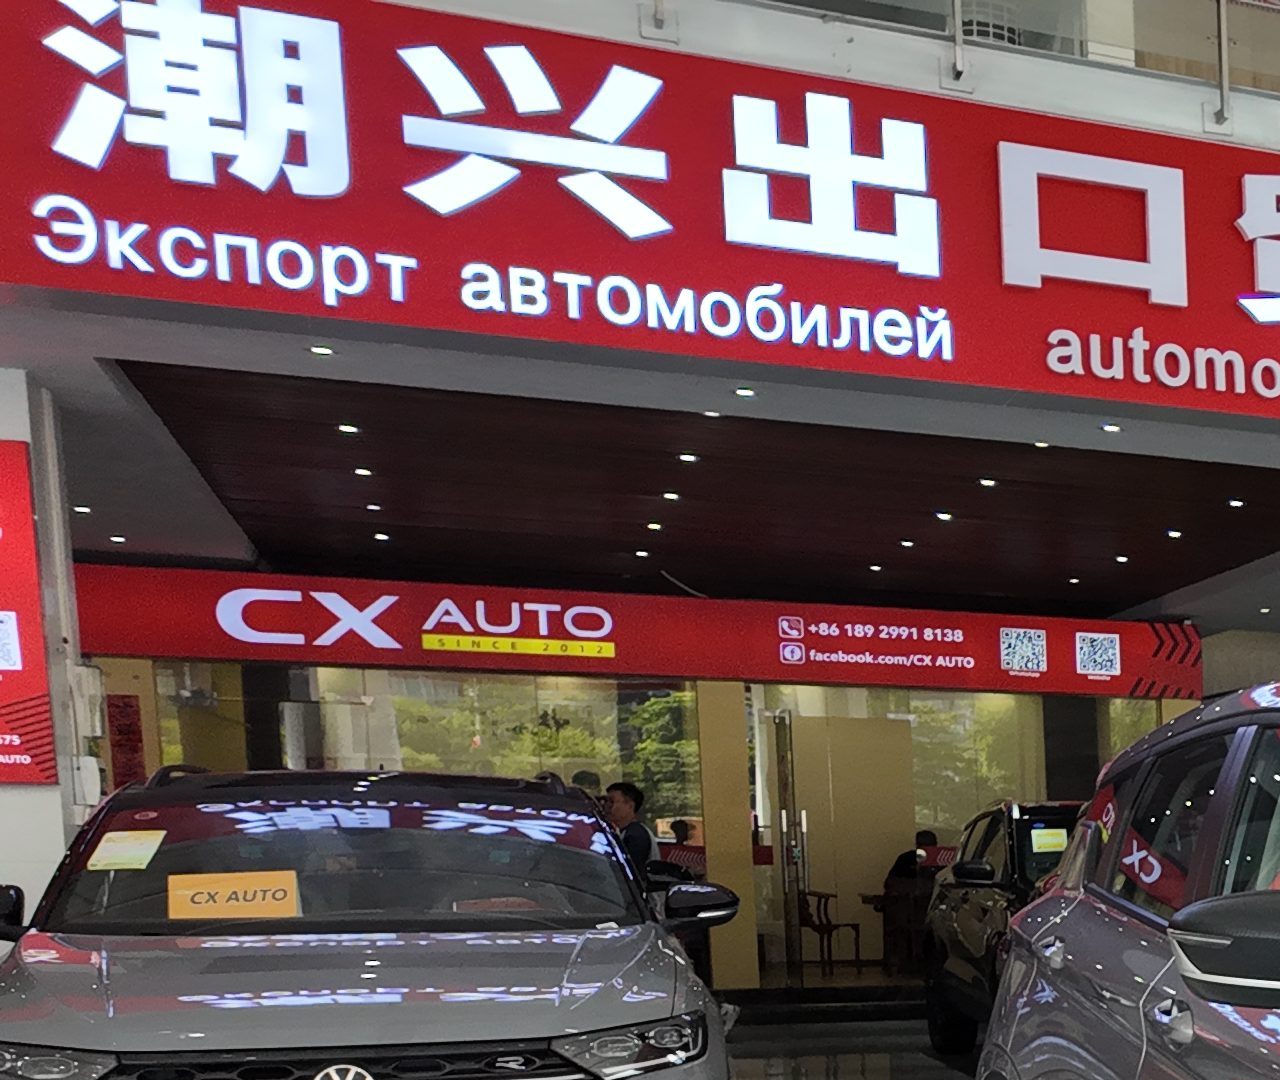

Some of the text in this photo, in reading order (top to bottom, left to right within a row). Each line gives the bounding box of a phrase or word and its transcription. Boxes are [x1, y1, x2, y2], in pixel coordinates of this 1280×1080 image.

[32, 194, 955, 362] Экспорт автомобилей
[216, 588, 614, 650] CX AUTO
[808, 622, 964, 643] +86 189 2991 8138
[437, 638, 606, 656] SINCE 2012
[809, 650, 976, 669] facebook.com/CX AUTO
[189, 888, 288, 905] CX AUTO
